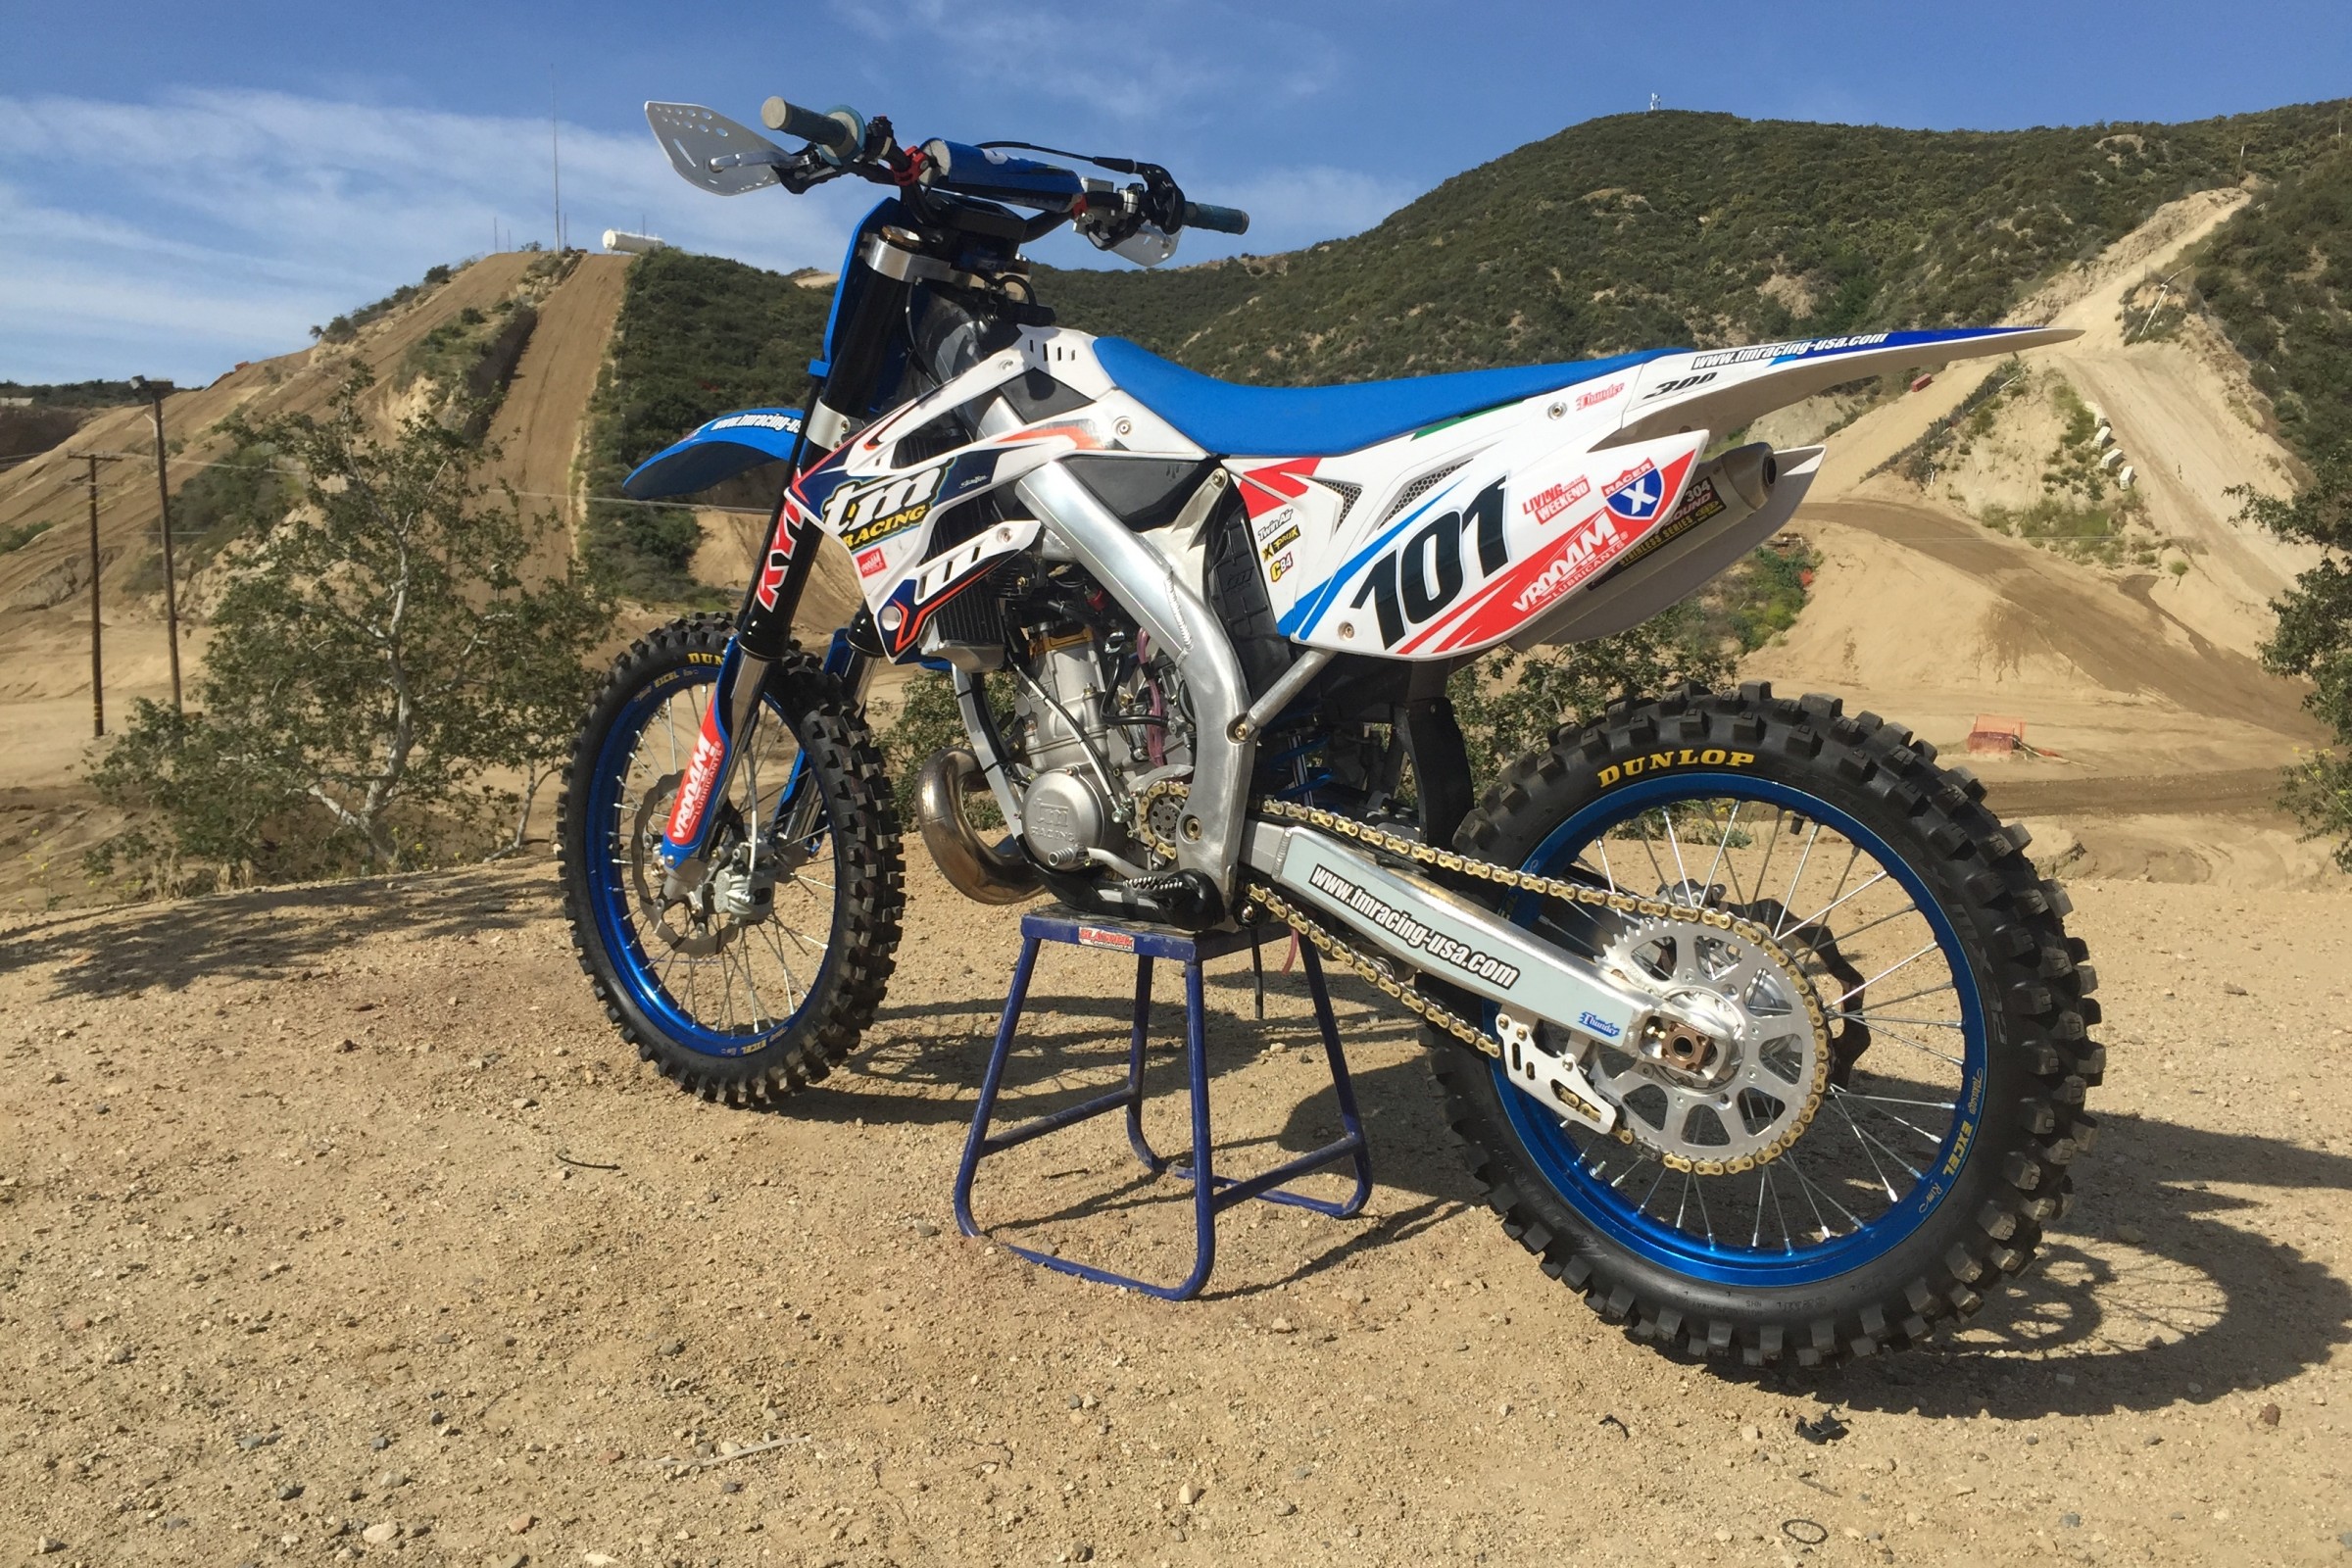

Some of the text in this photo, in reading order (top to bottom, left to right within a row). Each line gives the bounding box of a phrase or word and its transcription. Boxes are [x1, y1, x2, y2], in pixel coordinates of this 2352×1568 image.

[1691, 333, 1888, 369] www.tmracing-usa.com
[1642, 372, 1718, 400] 300
[1604, 462, 1653, 497] RACER
[1619, 477, 1657, 514] X
[1685, 478, 1711, 502] 304
[1522, 483, 1563, 514] LIVING
[1537, 481, 1588, 521] WEEKEND
[843, 505, 927, 548] RACING
[1662, 515, 1693, 538] SERIES
[1349, 475, 1508, 650] 101
[1597, 749, 1755, 788] DUNLOP
[1310, 866, 1520, 989] www.tmracing-usa.com
[1581, 1012, 1619, 1036] Thunder
[1942, 1120, 1973, 1176] EXCEL
